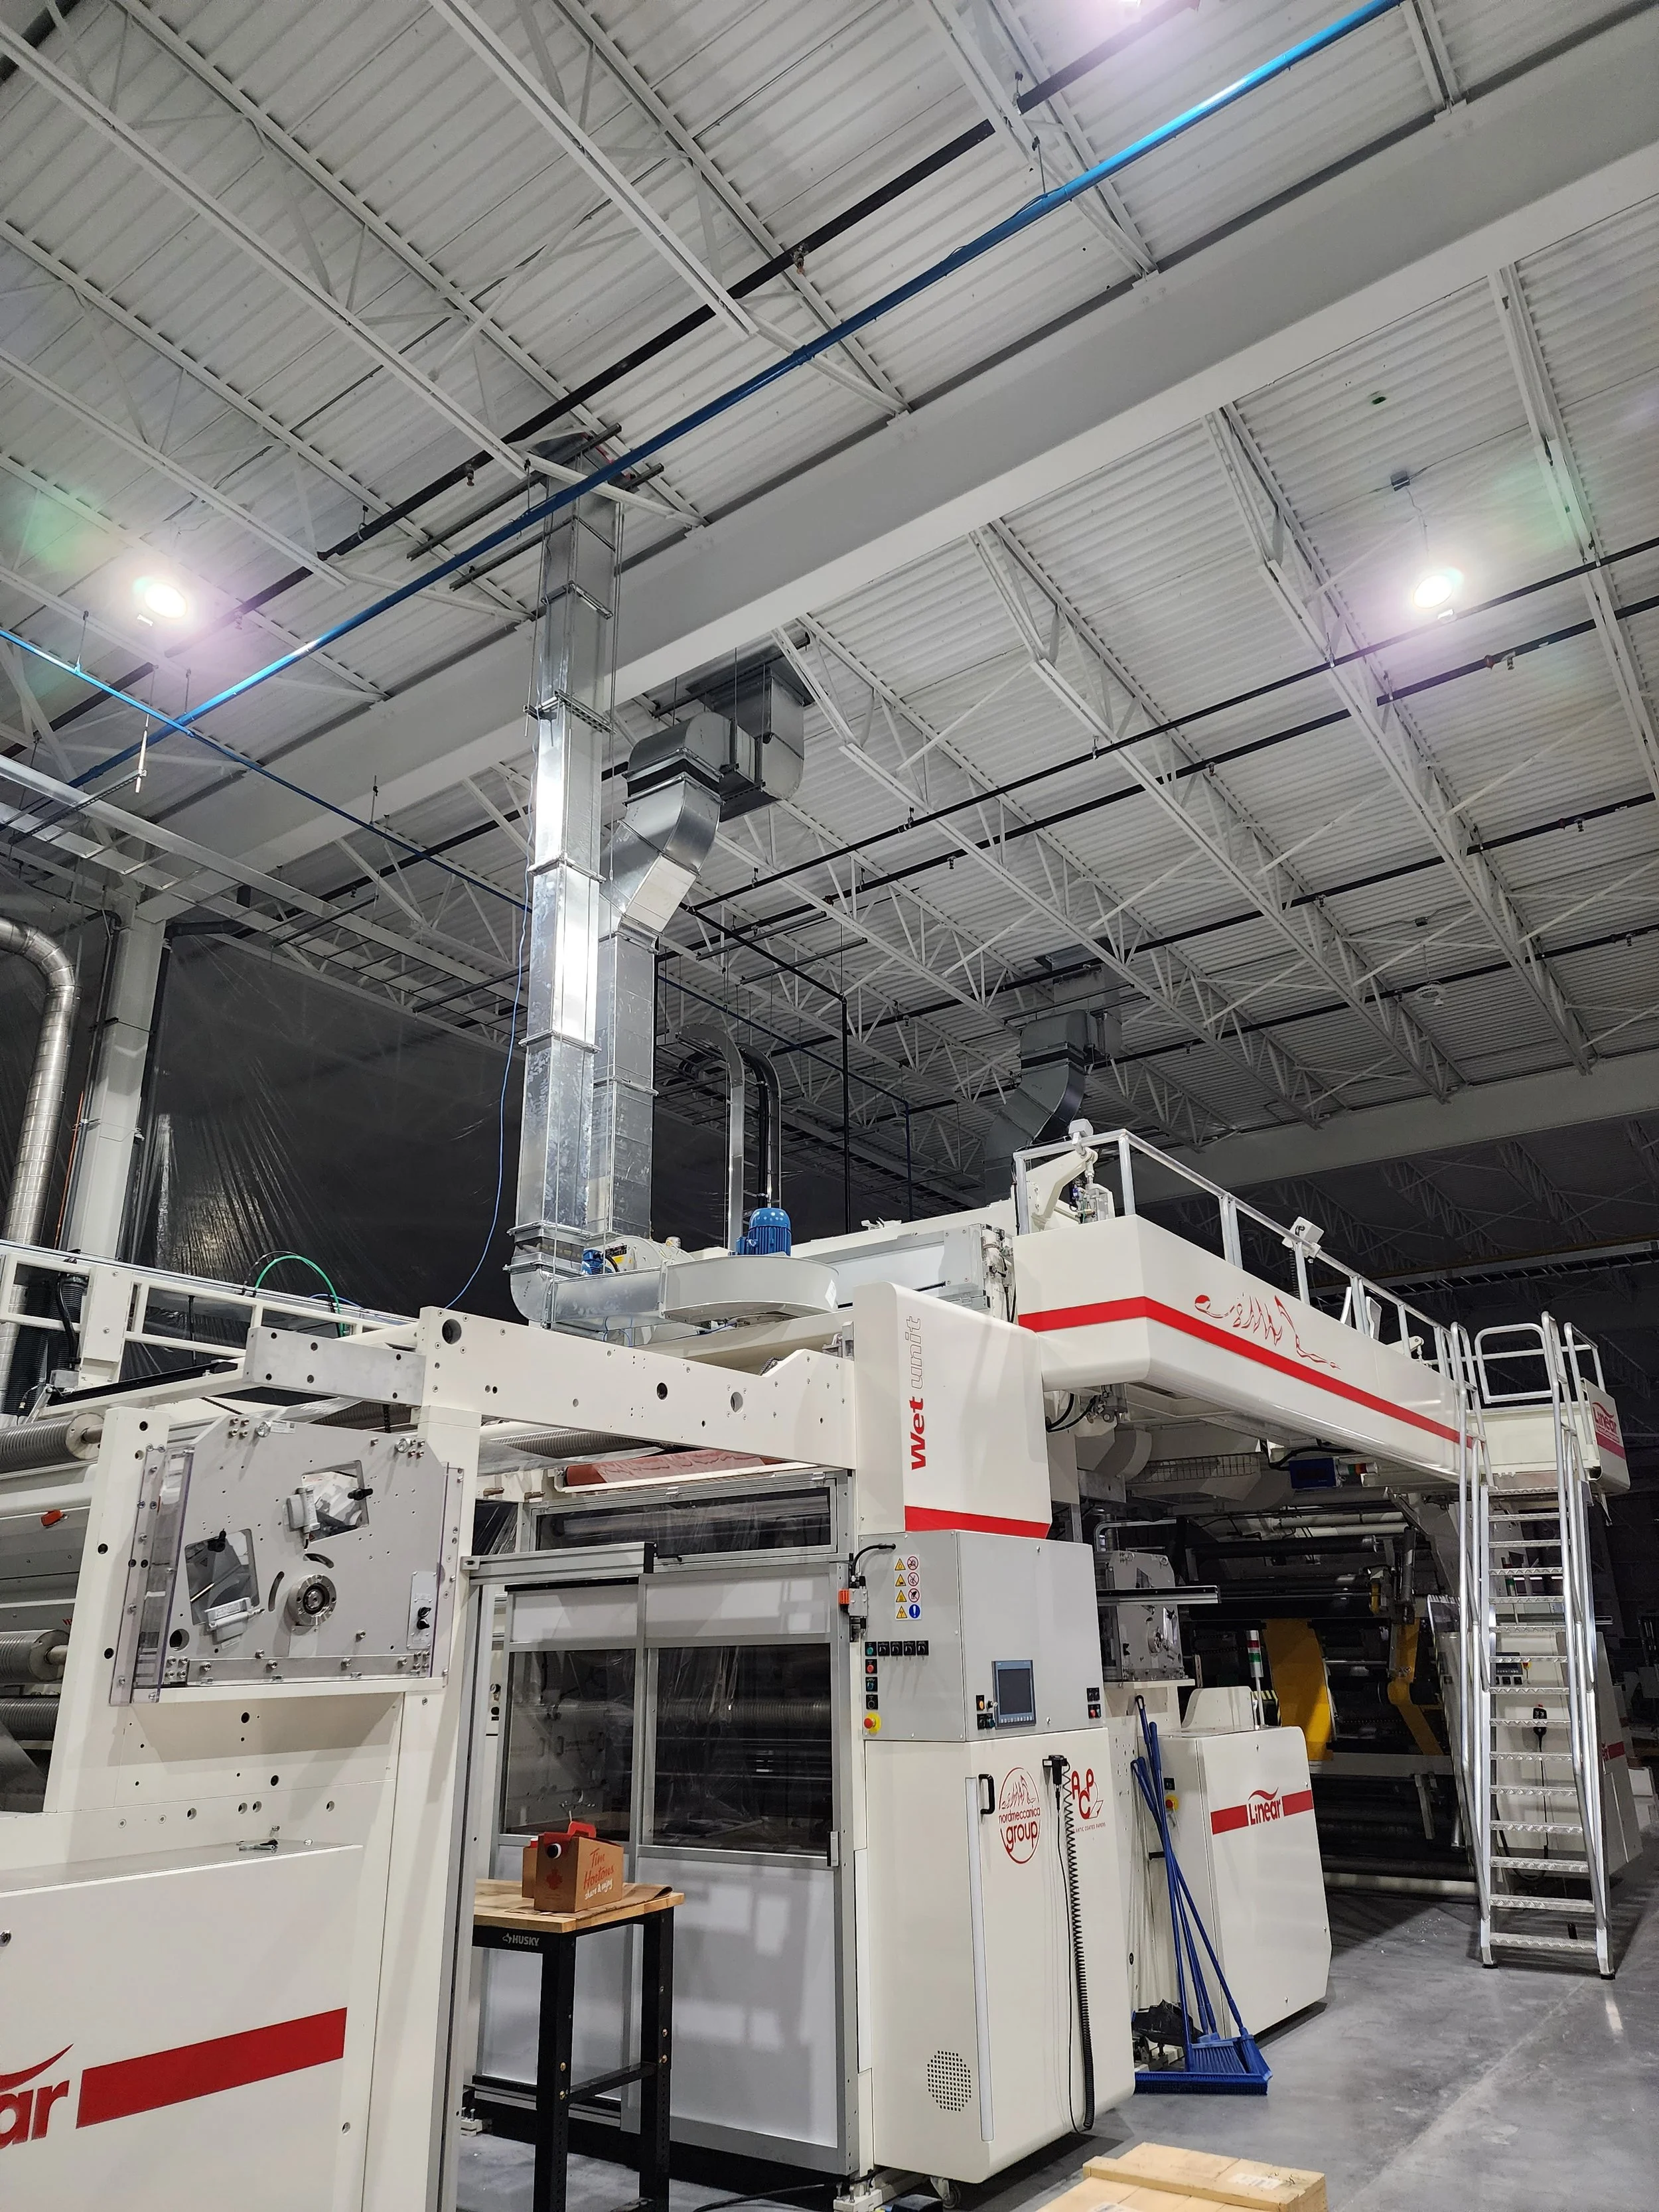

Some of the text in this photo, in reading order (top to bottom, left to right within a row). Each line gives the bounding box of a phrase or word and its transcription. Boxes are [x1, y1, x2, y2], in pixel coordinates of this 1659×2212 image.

[905, 1316, 926, 1471] Wet unit
[998, 1806, 1041, 1824] nordmeccanica
[1248, 1799, 1281, 1825] Linear
[1006, 1820, 1038, 1852] group
[589, 1848, 605, 1868] Tim
[583, 1866, 614, 1891] Hortons
[585, 1878, 613, 1900] share & enjoy
[512, 1934, 540, 1947] HUSKY
